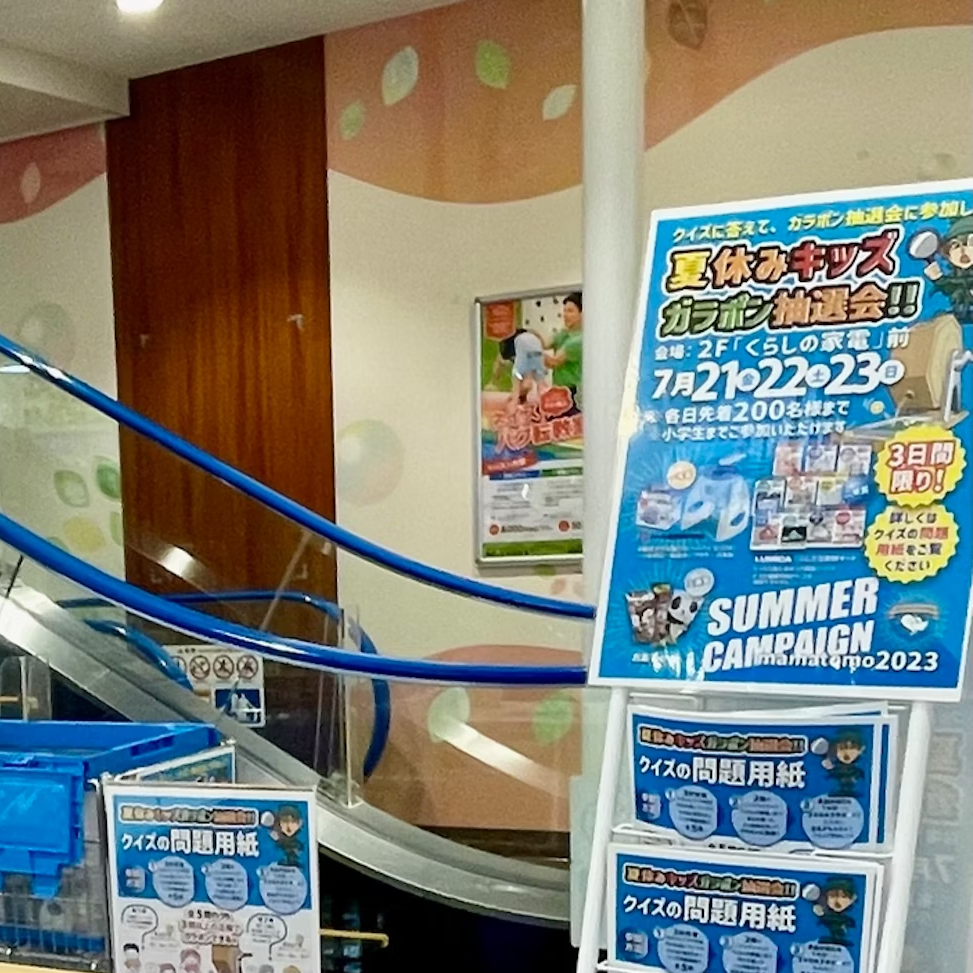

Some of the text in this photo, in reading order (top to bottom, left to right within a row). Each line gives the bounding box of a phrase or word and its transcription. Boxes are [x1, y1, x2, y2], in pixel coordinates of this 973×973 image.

[666, 231, 900, 292] 夏休みキッズ
[889, 441, 956, 467] 3日間
[707, 576, 879, 636] SUMMER
[702, 619, 875, 674] CAMPAIGN
[638, 755, 806, 789] クイズの問題用紙
[121, 828, 260, 858] クイズの問題用紙
[623, 895, 797, 933] クイズの問題用紙
